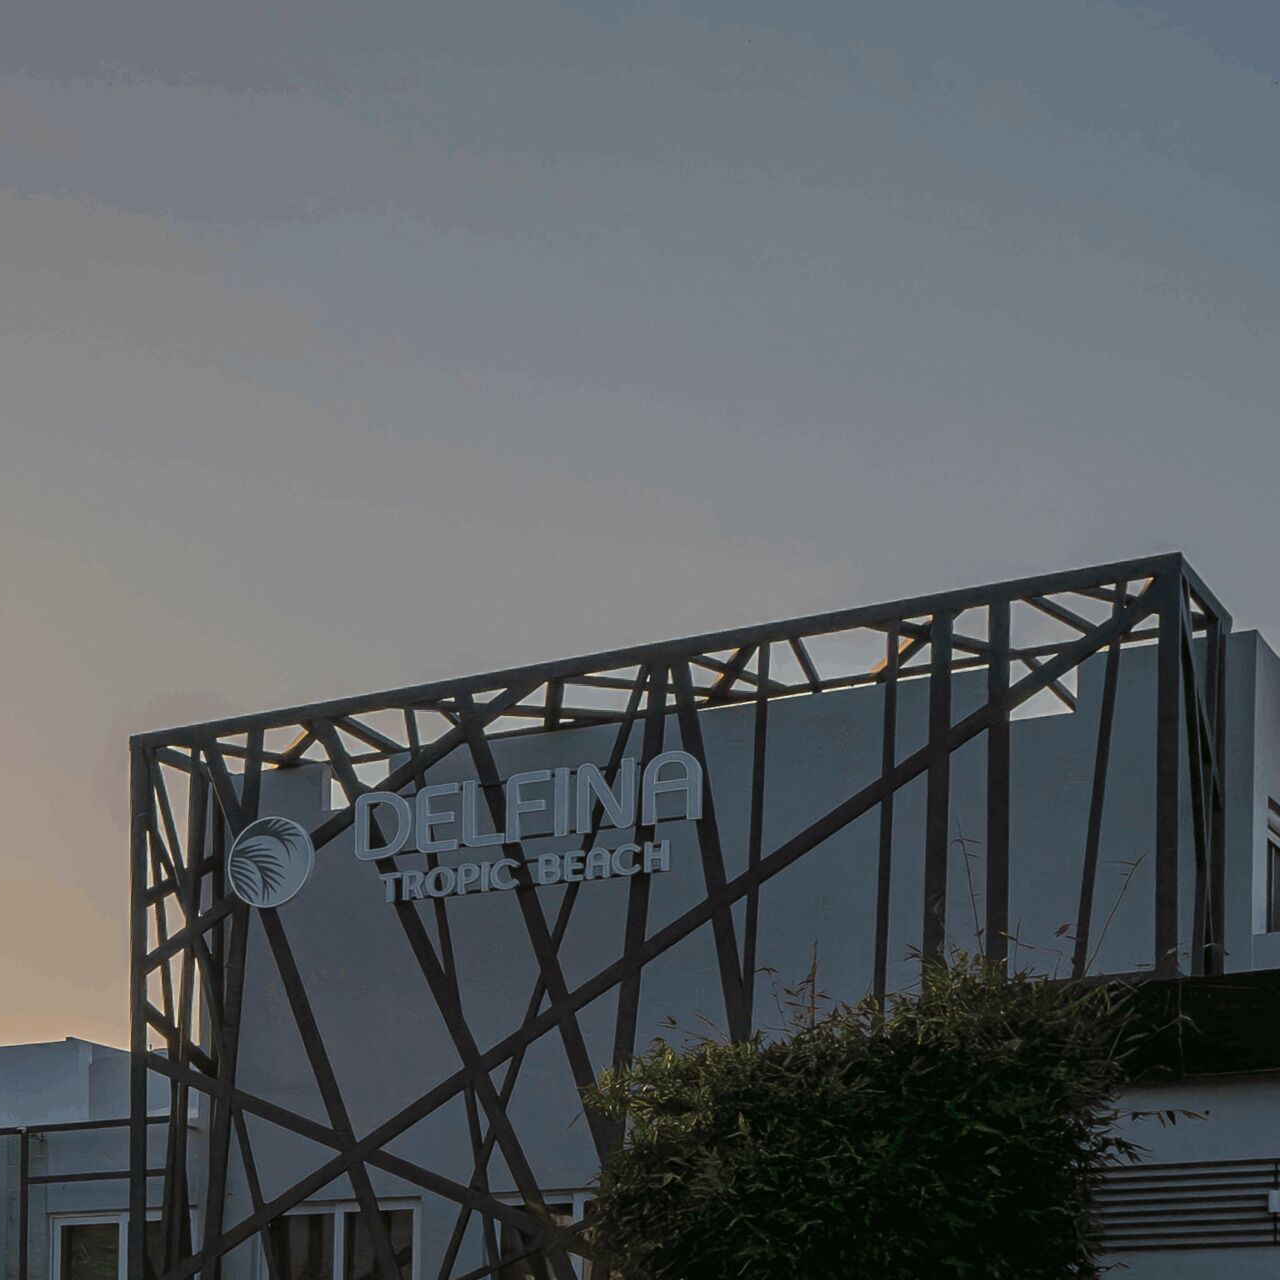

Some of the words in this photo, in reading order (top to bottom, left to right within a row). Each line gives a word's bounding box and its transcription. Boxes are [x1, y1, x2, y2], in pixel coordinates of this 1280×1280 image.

[354, 751, 703, 860] DELFINA
[380, 859, 520, 903] TROPIC
[539, 840, 671, 884] BEACH
